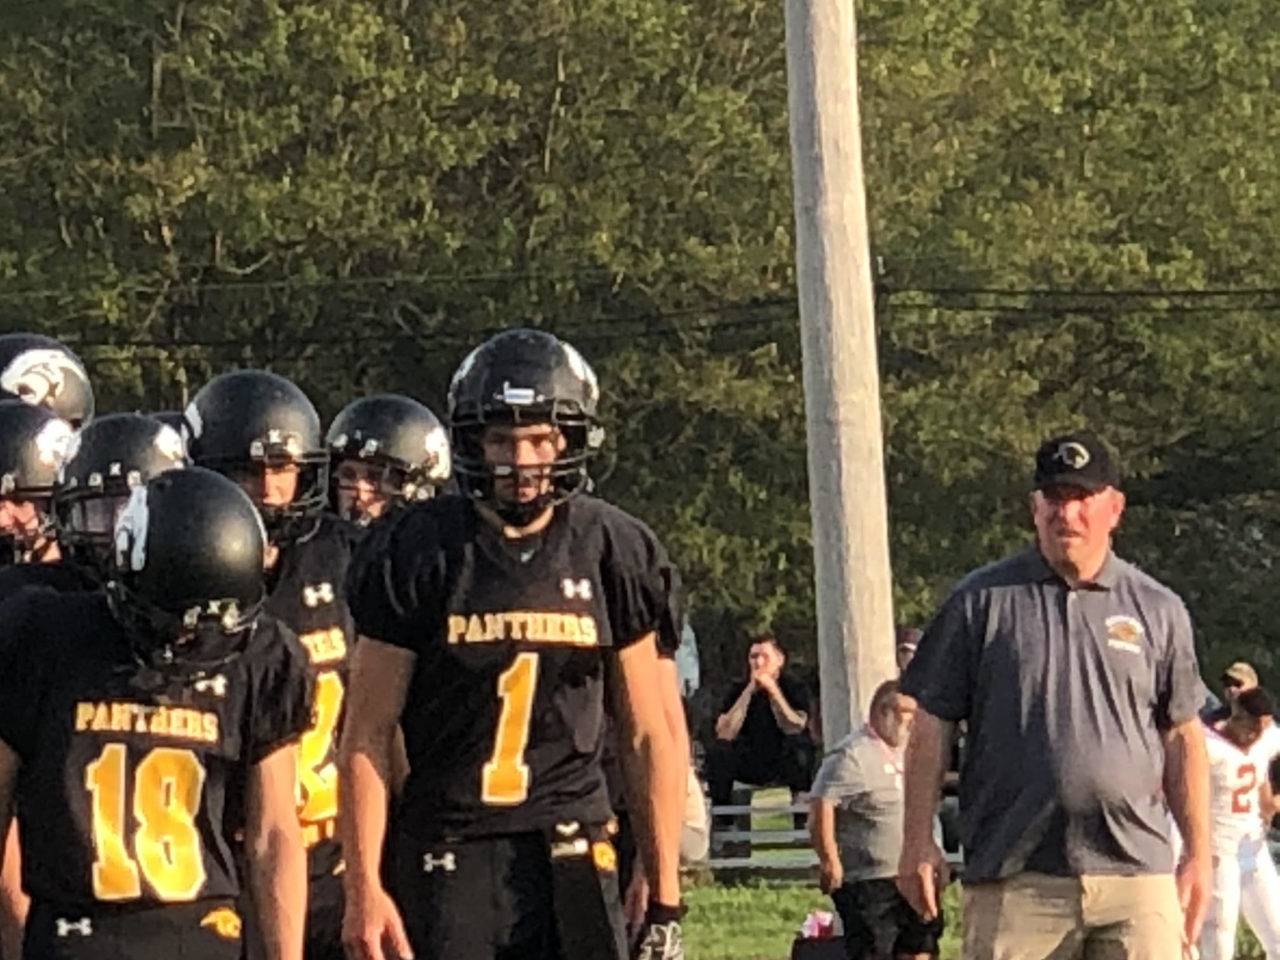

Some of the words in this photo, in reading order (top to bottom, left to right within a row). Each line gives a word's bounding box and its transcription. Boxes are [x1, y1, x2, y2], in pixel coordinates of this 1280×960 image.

[447, 612, 598, 646] PANTHERS
[75, 702, 219, 742] PANTHERS
[481, 651, 539, 804] 1
[1231, 763, 1257, 813] 2
[85, 742, 207, 901] 18
